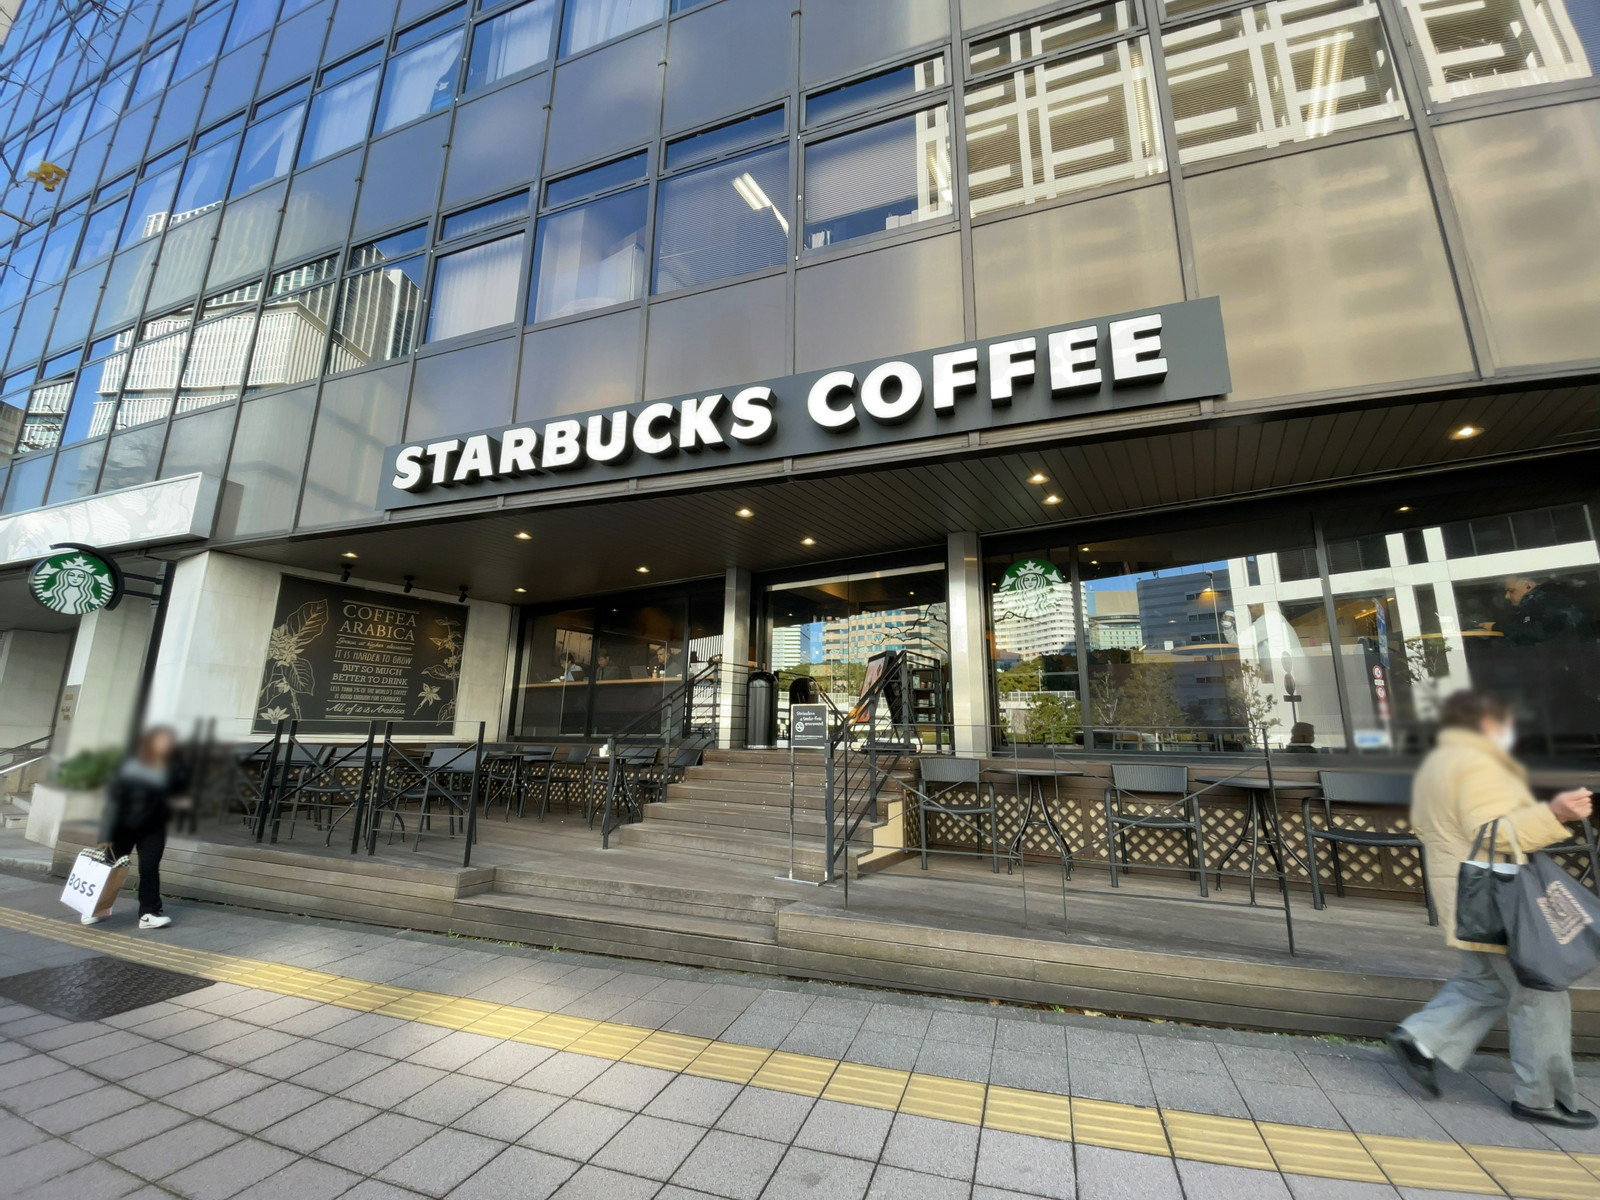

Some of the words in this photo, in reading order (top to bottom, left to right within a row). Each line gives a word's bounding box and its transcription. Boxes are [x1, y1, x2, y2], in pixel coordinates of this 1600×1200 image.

[392, 386, 778, 492] STARBUCKS
[807, 313, 1169, 433] COFFEE
[343, 604, 417, 627] COFFEA
[339, 620, 415, 641] ARABICA
[335, 650, 342, 658] IT
[344, 651, 351, 660] IS
[353, 652, 381, 662] HARDER
[382, 655, 390, 663] TO
[392, 656, 413, 665] GROW
[342, 664, 360, 672] BUT
[361, 666, 374, 674] SO
[375, 667, 403, 676] MUCH
[332, 673, 366, 683] BETTER
[381, 677, 409, 686] DRINK
[326, 703, 344, 712] All
[345, 704, 358, 715] of
[371, 705, 406, 714] Arabica
[68, 873, 96, 897] BOSS
